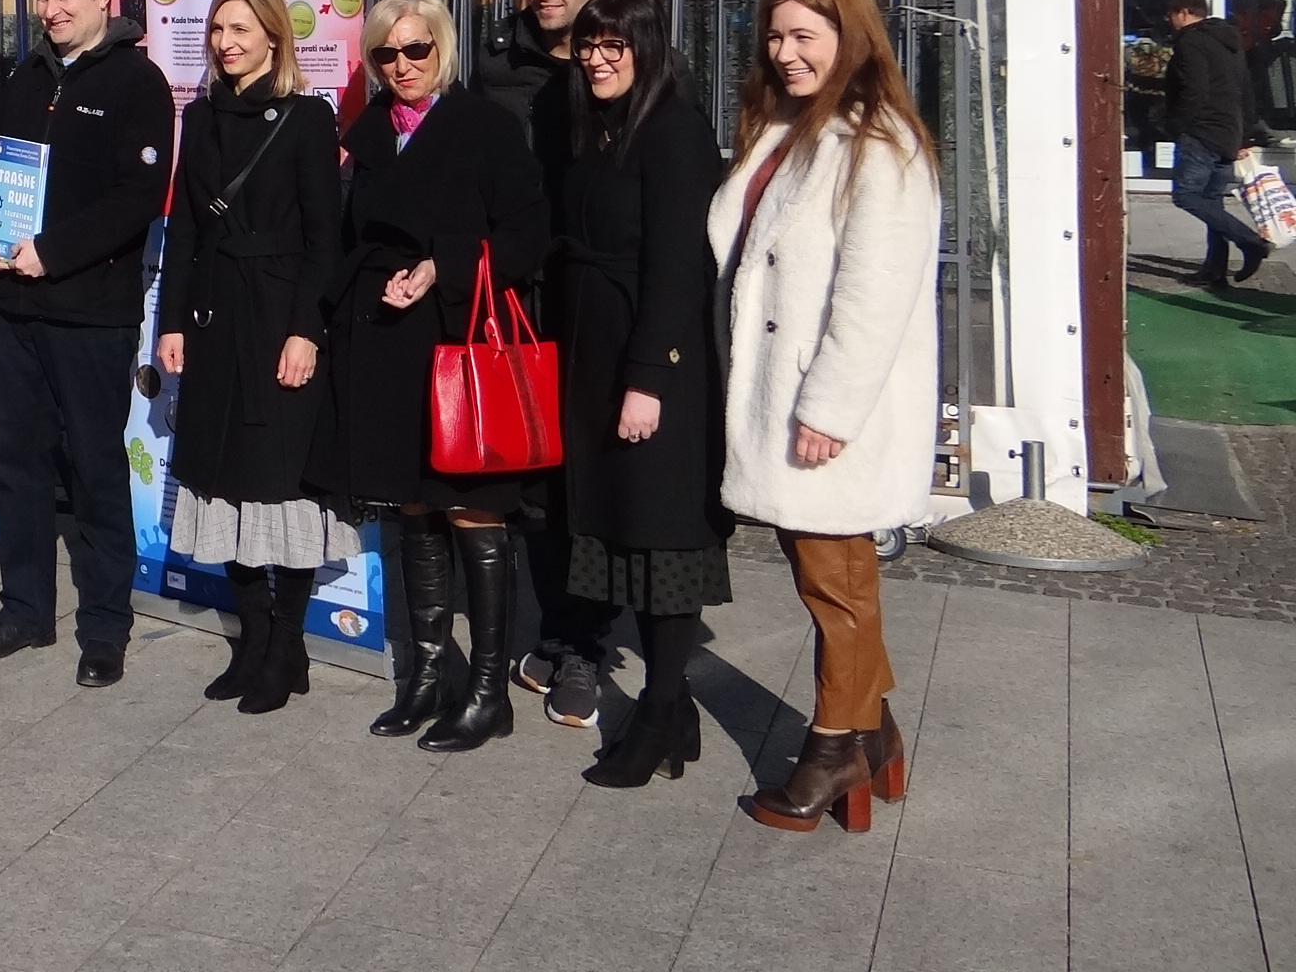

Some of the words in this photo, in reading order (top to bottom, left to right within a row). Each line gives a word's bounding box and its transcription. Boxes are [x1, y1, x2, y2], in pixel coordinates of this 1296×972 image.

[171, 16, 186, 24] Kada
[188, 16, 203, 24] treba
[301, 44, 317, 54] prati
[319, 44, 338, 53] ruke?
[8, 190, 34, 208] RUKE
